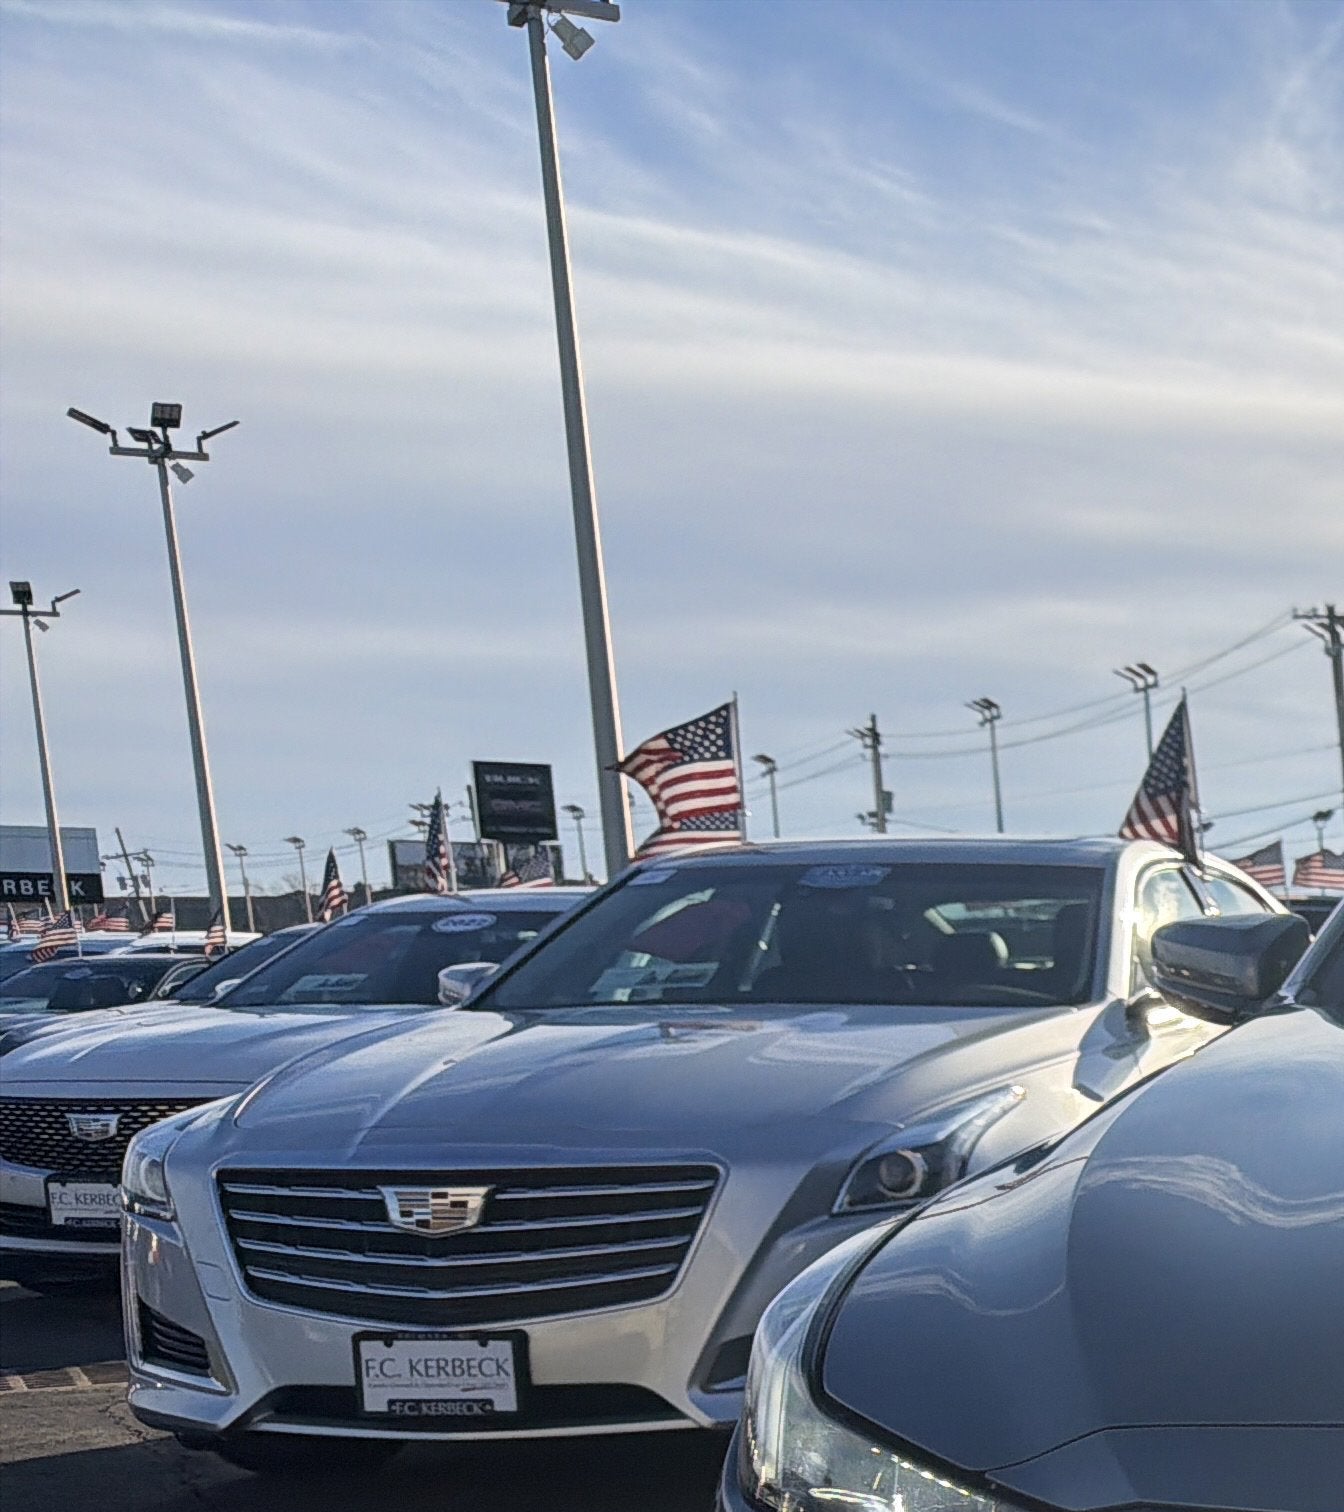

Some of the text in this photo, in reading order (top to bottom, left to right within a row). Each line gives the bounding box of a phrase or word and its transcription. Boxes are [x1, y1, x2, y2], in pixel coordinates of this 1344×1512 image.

[1, 878, 86, 897] RBEK
[74, 1191, 121, 1207] KERBEC
[364, 1357, 511, 1378] F.C. KERBECK
